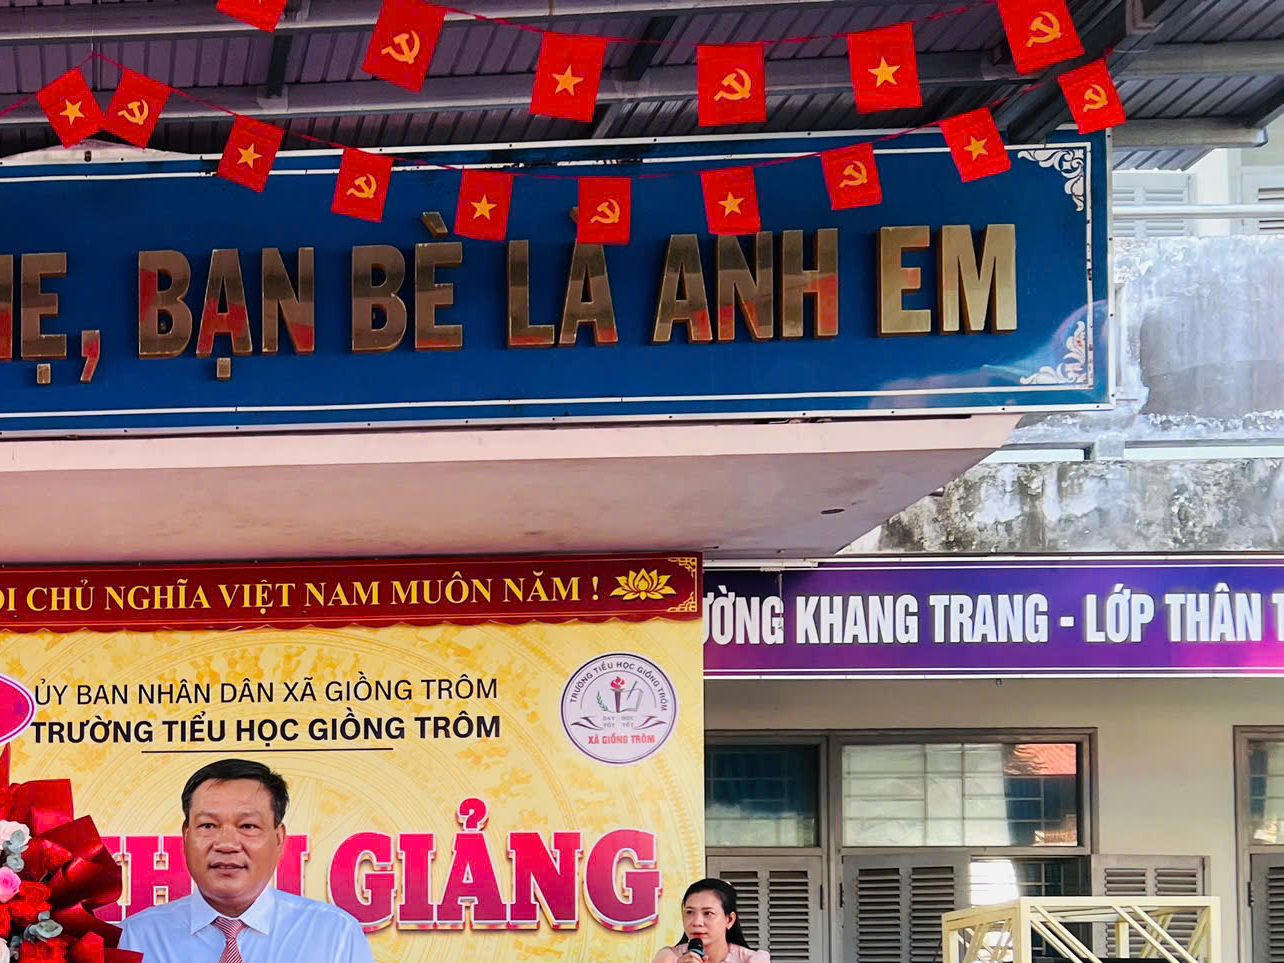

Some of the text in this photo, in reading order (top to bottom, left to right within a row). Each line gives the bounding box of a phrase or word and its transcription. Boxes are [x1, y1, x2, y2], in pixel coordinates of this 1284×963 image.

[138, 245, 315, 381] BẠN
[351, 208, 464, 353] BÈ
[651, 228, 838, 344] ANH
[878, 223, 1018, 337] EM
[26, 578, 95, 611] CHỦ
[105, 579, 211, 610] NGHĨA
[218, 575, 296, 615] VIỆT
[303, 581, 380, 607] NAM
[390, 571, 494, 605] MUÔN
[503, 570, 581, 602] NĂM
[796, 594, 918, 644] KHANG
[930, 593, 1049, 643] TRANG
[1084, 583, 1155, 642] LỚP
[1165, 582, 1261, 641] THÂN
[35, 671, 497, 705] ỦY BAN NHÂN DÂN XÃ GIỒNG TRÔM
[31, 707, 500, 747] TRƯỜNG TIỂU HỌC GIỒNG TRÔM
[314, 797, 663, 932] GIẢNG
